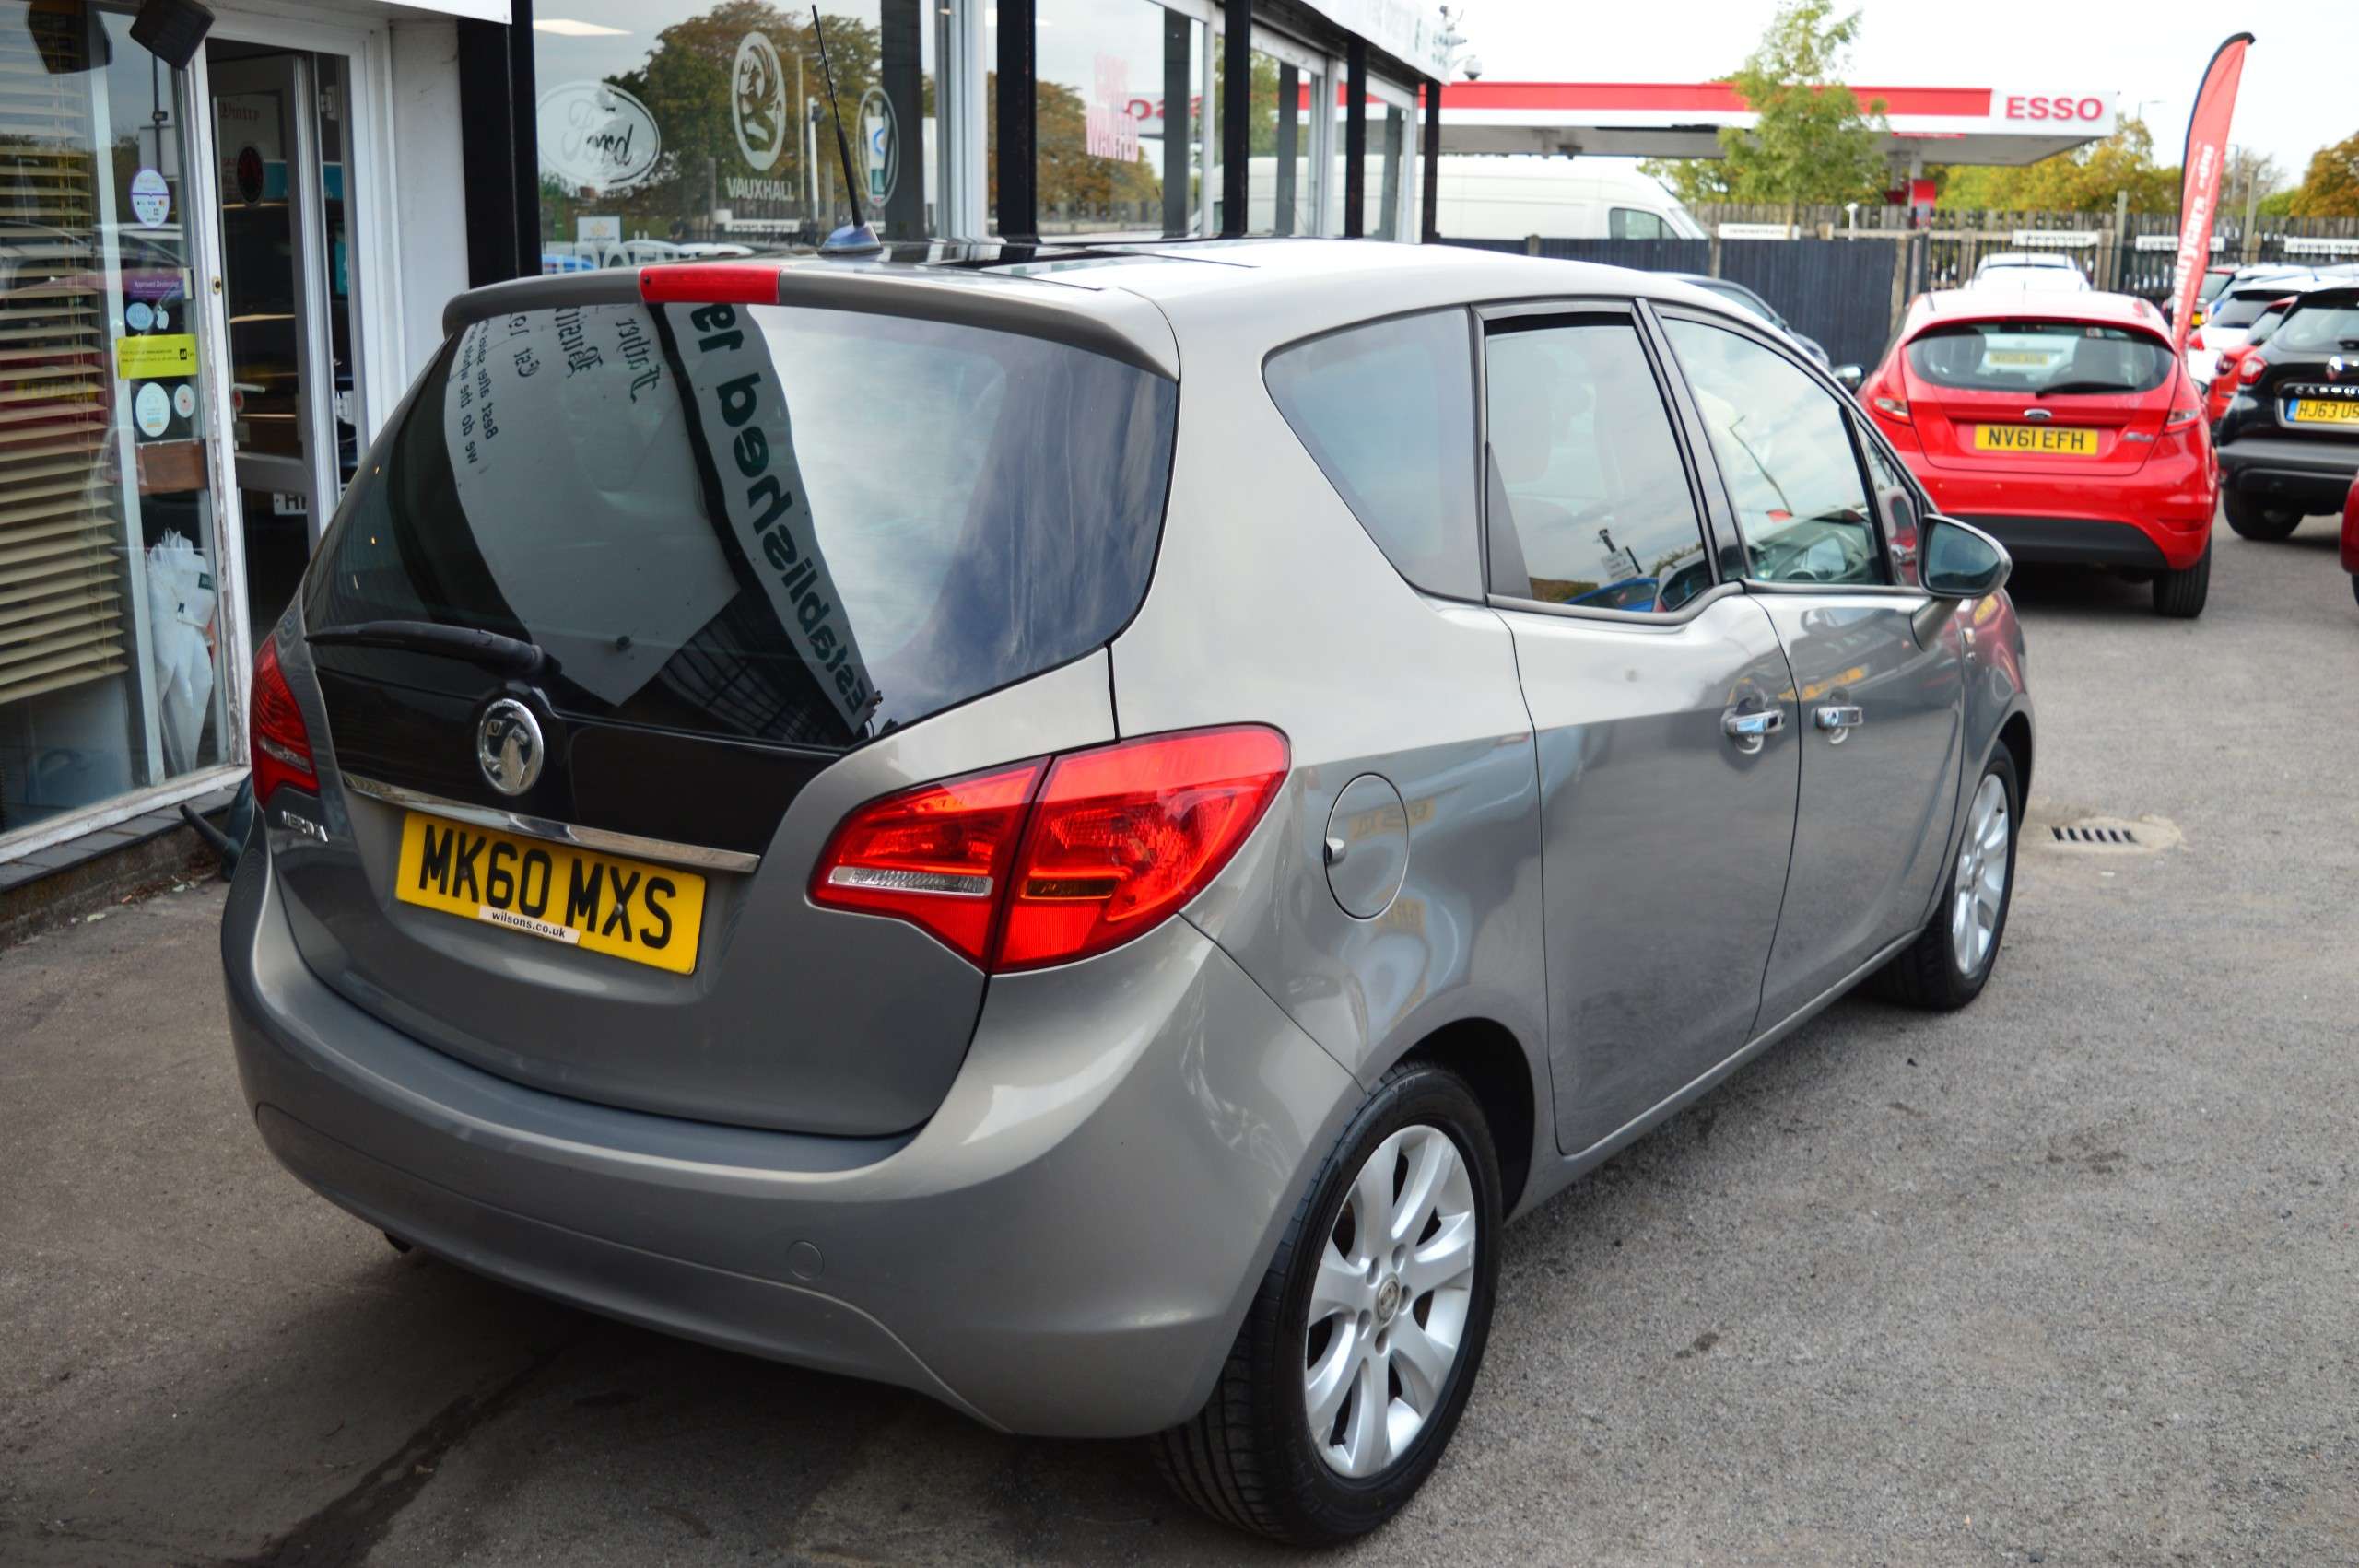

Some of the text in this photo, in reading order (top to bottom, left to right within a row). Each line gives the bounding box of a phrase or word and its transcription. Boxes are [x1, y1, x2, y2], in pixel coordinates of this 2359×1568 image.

[2005, 97, 2104, 122] ESSO
[726, 177, 795, 202] VAUXHALL
[2298, 402, 2338, 419] HJ63
[1989, 427, 2085, 451] NV61 EFH
[418, 824, 677, 951] MK60 MXS
[491, 910, 566, 940] wilsons.co.uk
